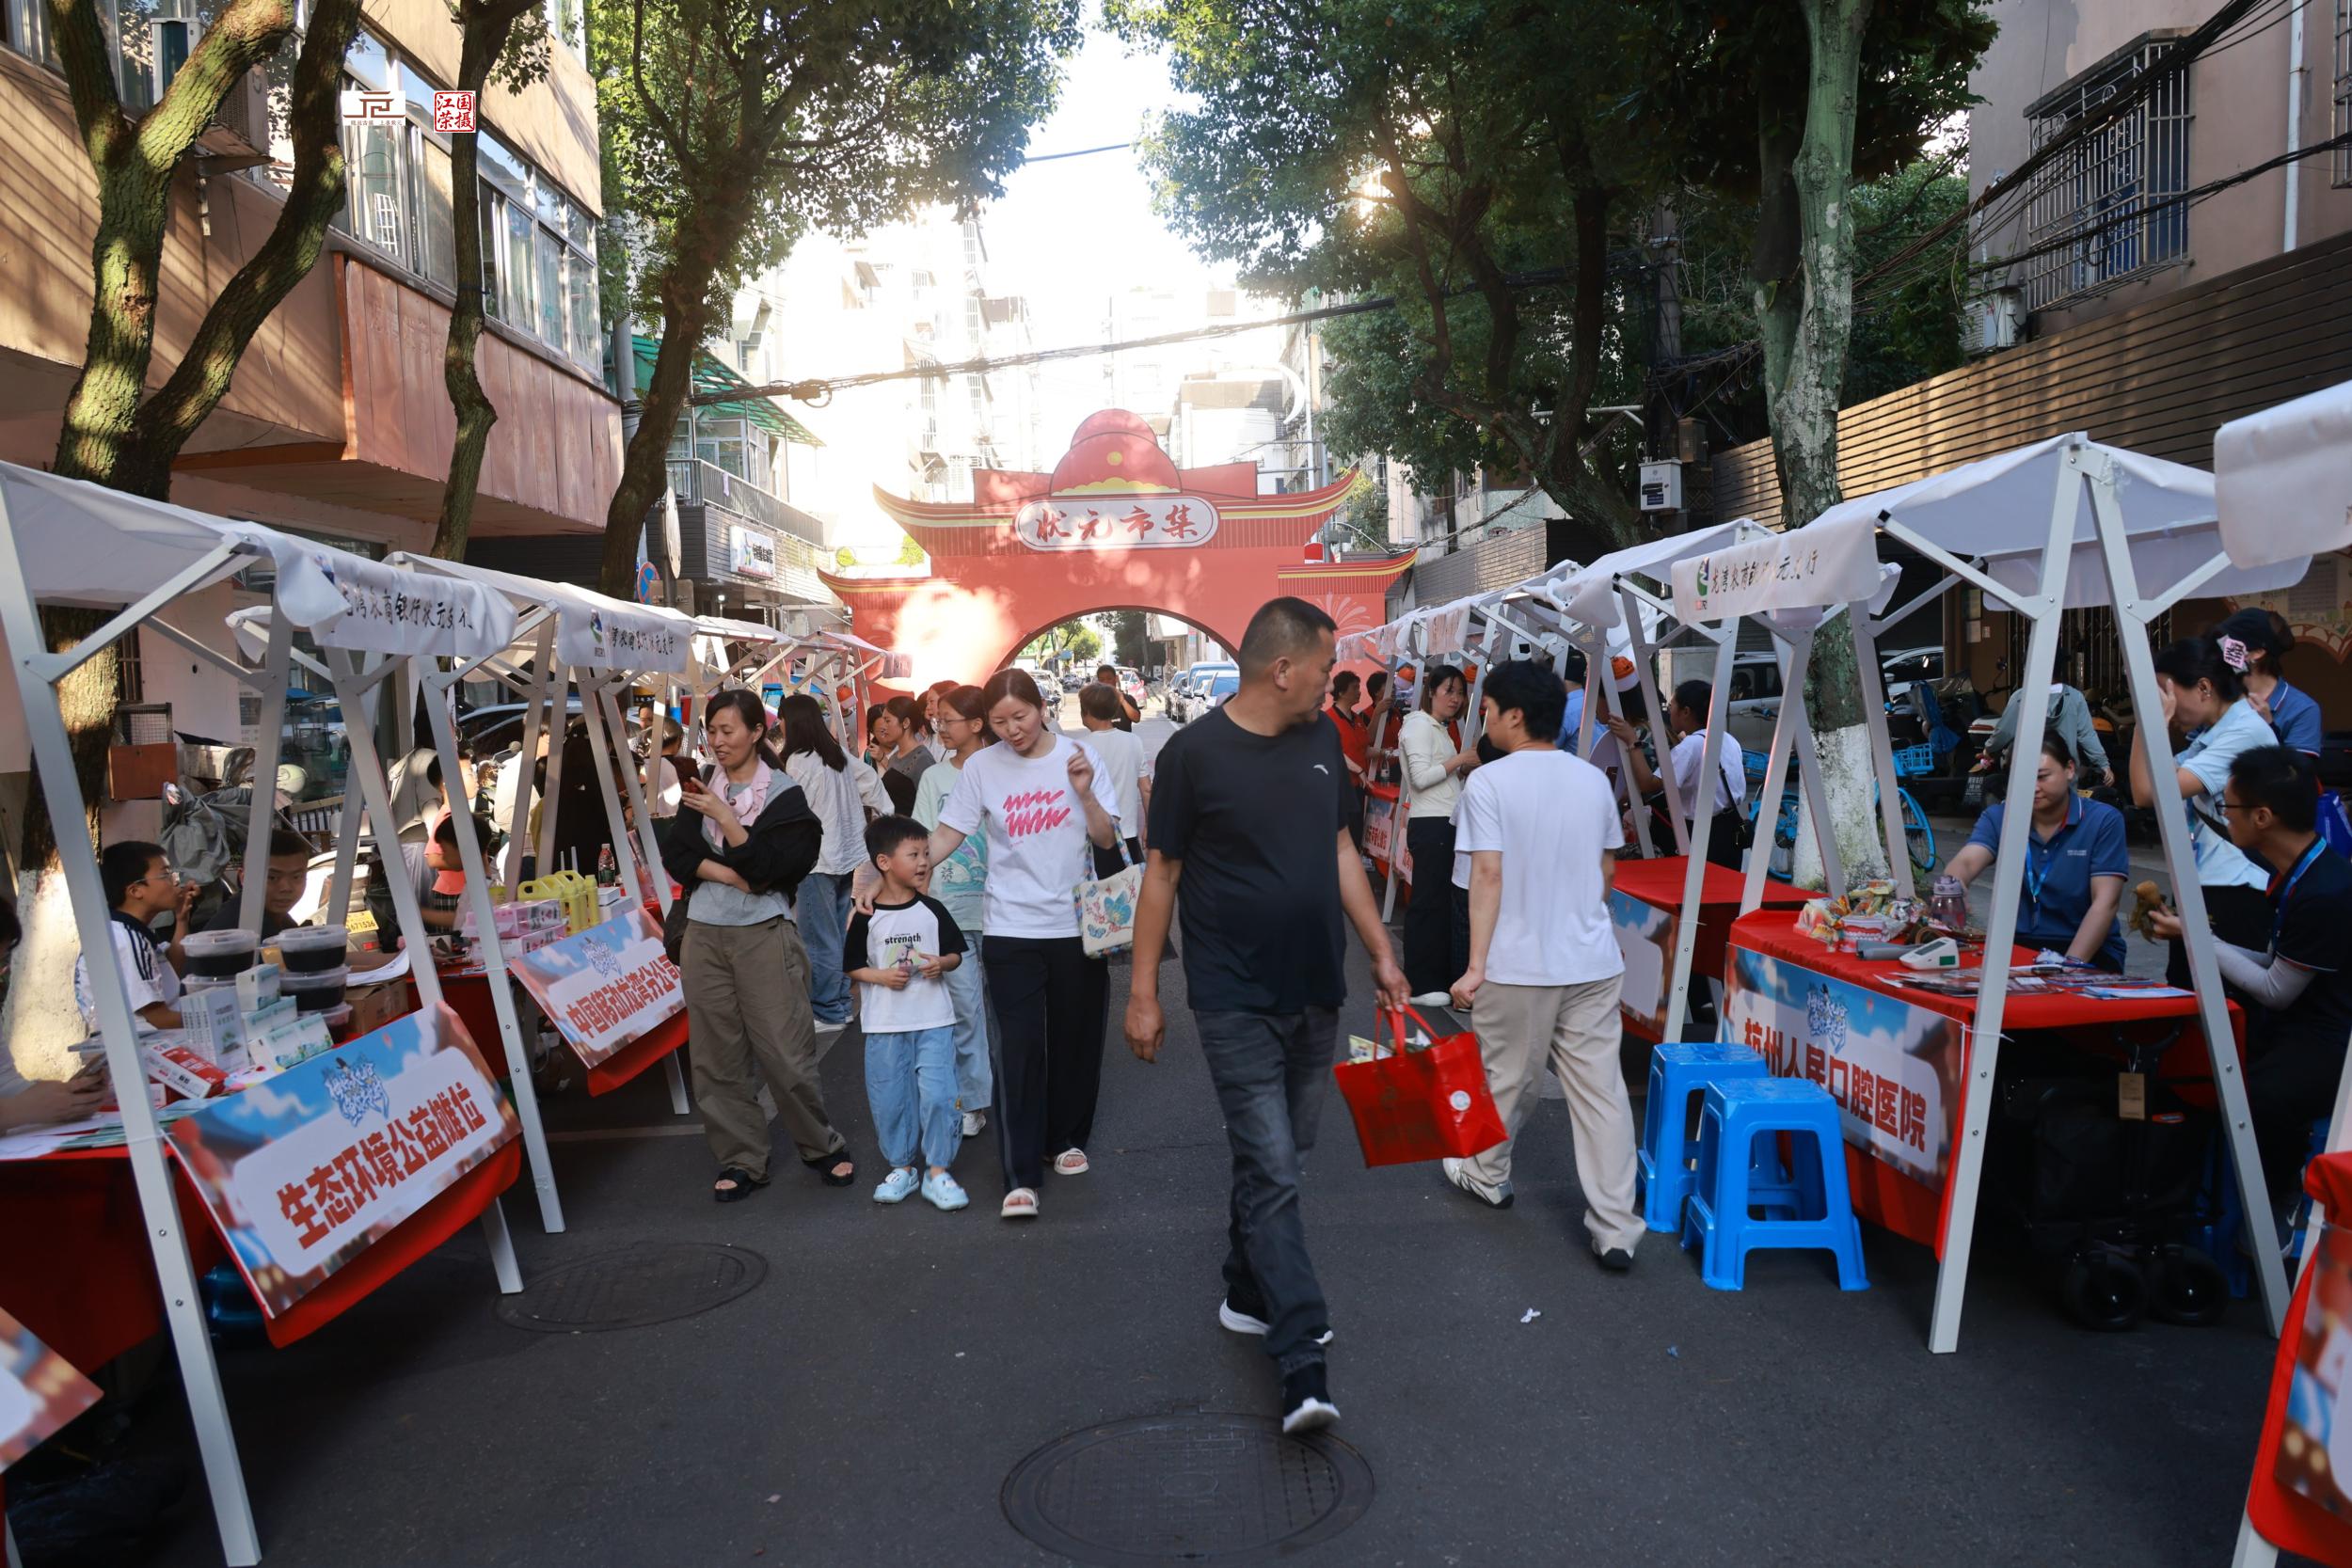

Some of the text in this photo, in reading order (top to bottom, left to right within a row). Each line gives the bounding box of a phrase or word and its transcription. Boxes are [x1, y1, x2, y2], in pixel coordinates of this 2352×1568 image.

[1036, 505, 1198, 542] 状元市集
[1710, 549, 1818, 594] 龙湾农商银行元支行
[566, 954, 681, 1038] 中国移动龙湾分公司
[1744, 1017, 1927, 1152] 杭州人民口腔医院
[277, 1082, 486, 1250] 生态环境公益摊位
